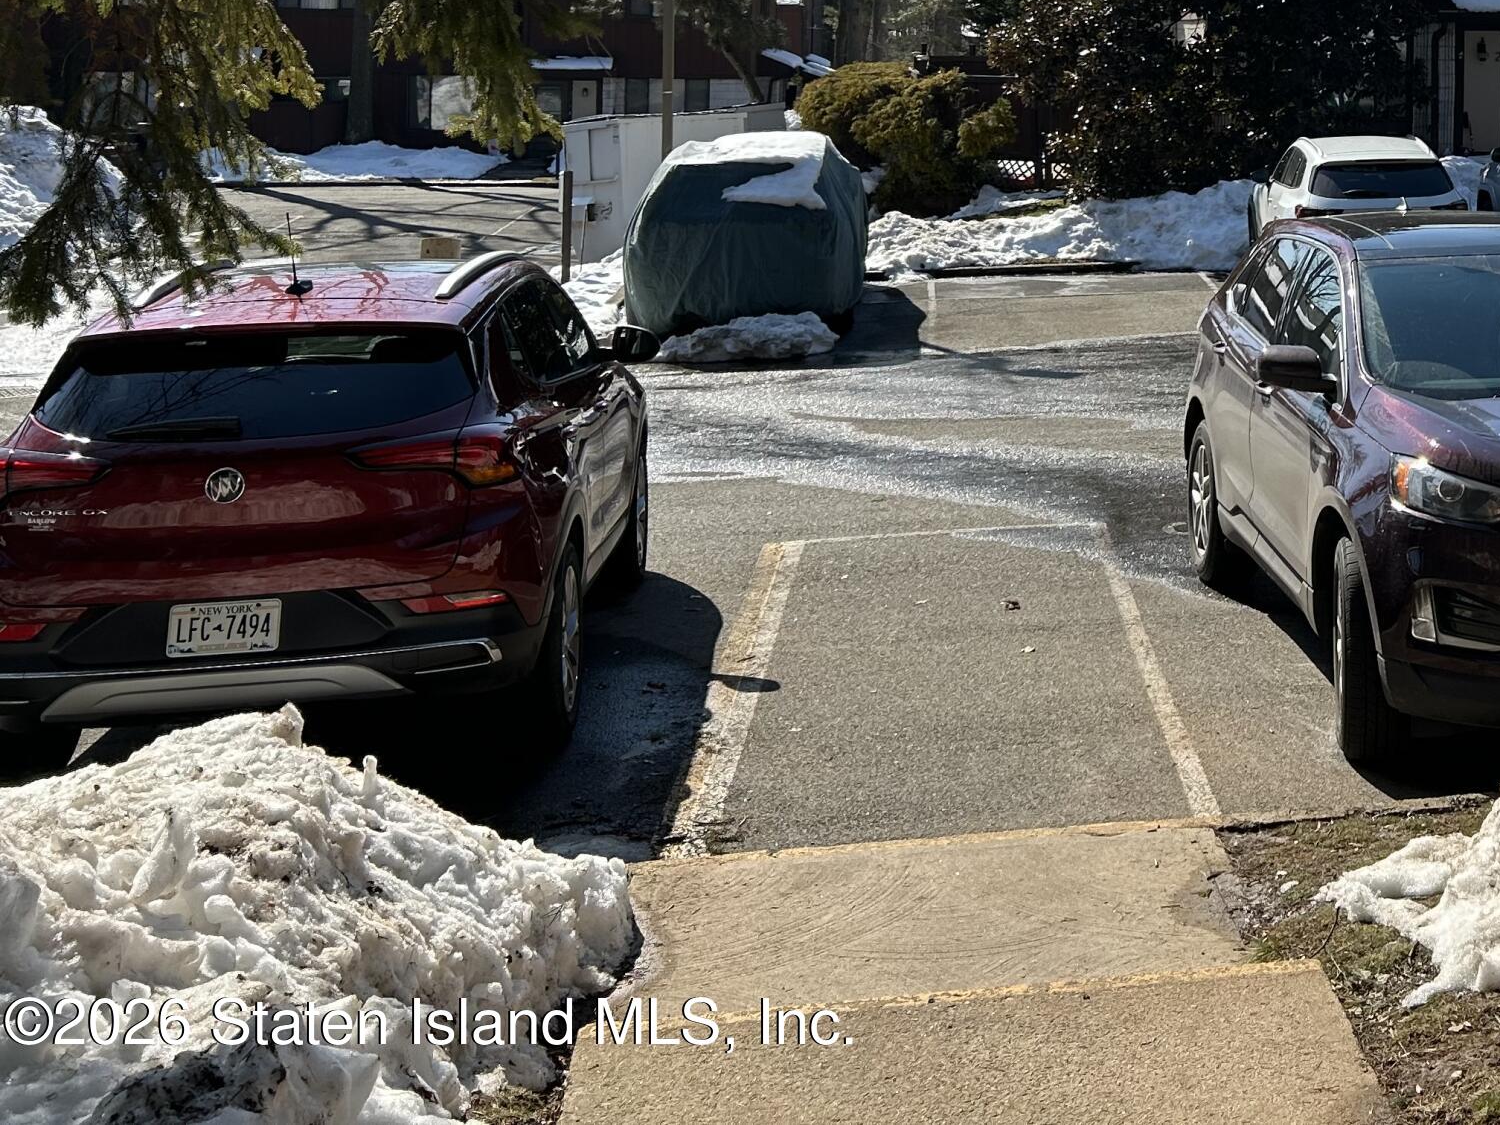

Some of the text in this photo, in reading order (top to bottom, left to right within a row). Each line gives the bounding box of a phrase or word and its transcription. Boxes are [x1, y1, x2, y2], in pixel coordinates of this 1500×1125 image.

[82, 508, 109, 516] GX
[199, 604, 254, 616] NEW YORK
